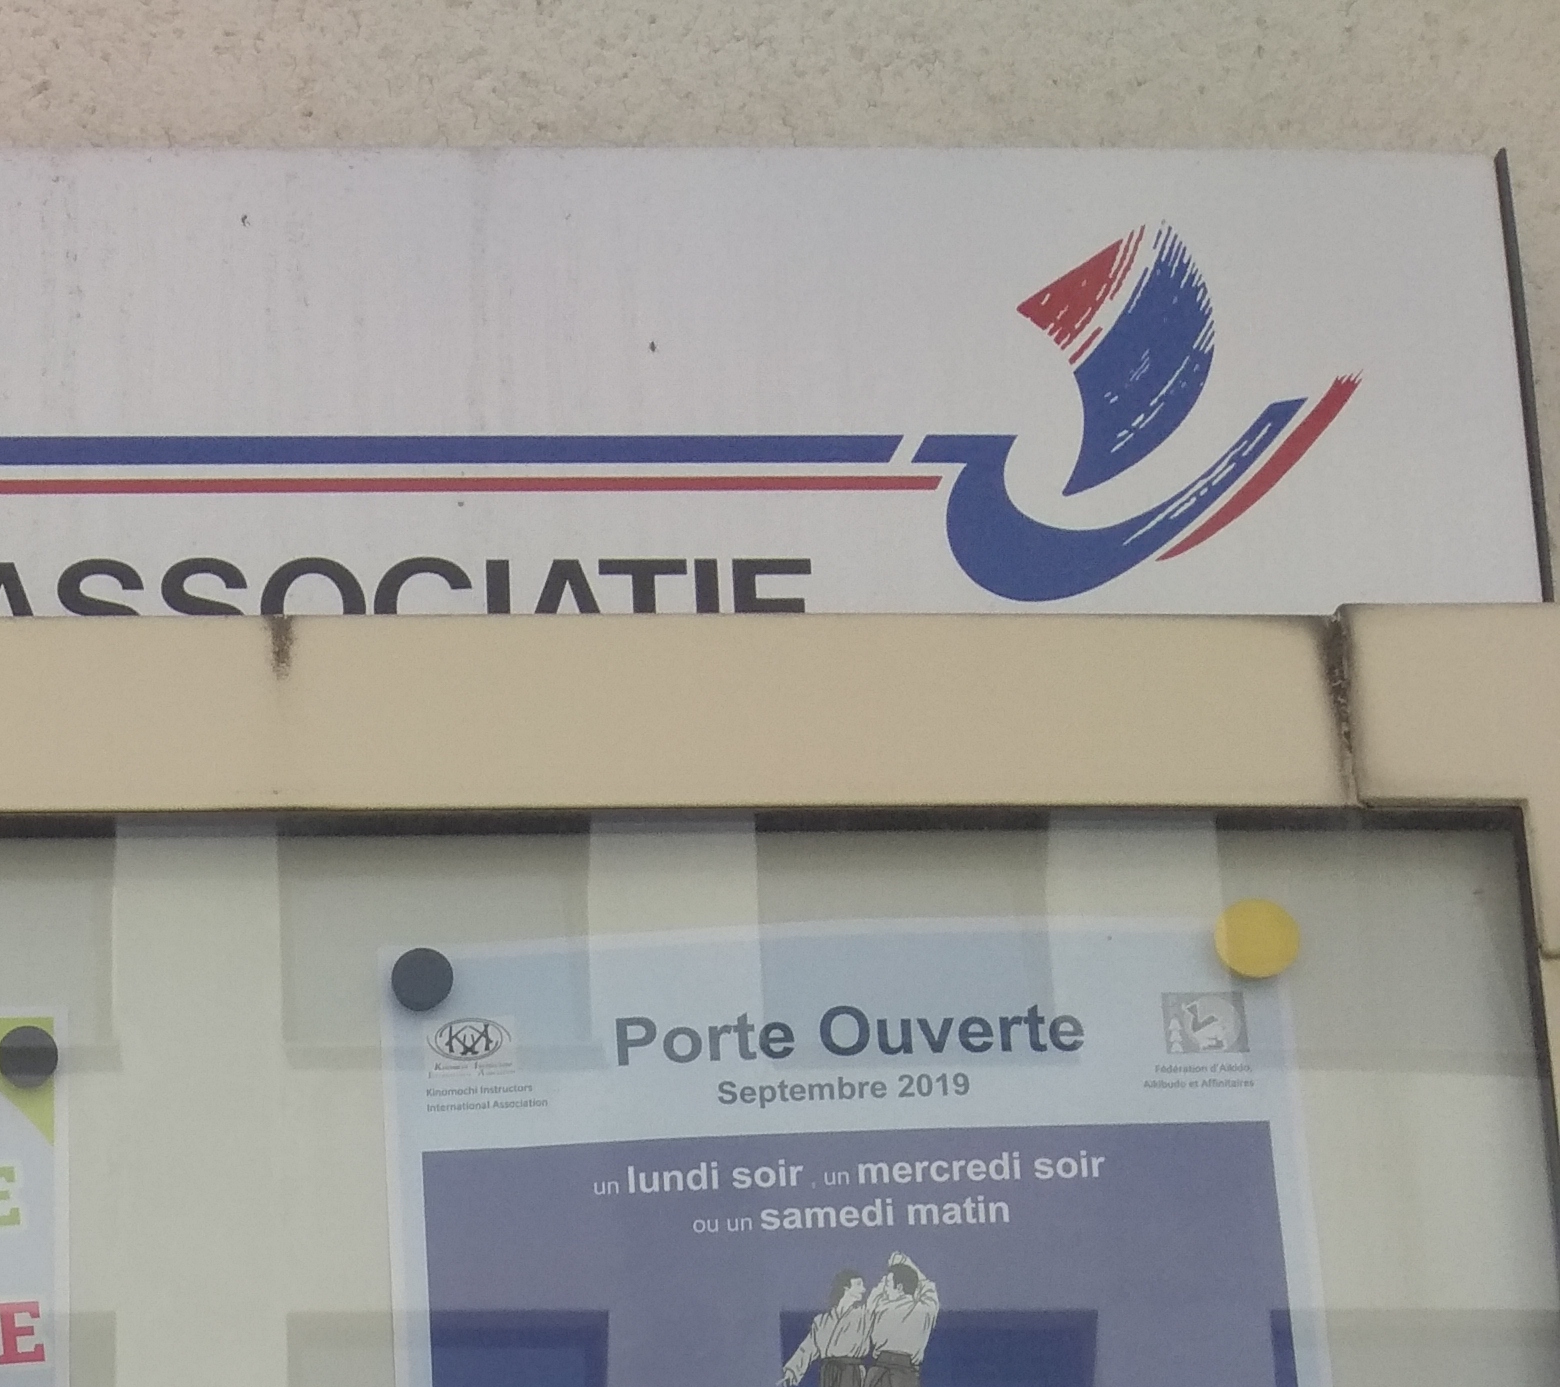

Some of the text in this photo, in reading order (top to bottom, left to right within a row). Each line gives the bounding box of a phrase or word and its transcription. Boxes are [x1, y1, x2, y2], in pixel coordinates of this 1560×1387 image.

[616, 1003, 1086, 1066] Porte Ouverte
[427, 1099, 548, 1112] International Association
[716, 1071, 971, 1110] Septembre 2019
[626, 1150, 1105, 1194] lundi soir mercredi soir
[760, 1195, 1011, 1230] samedi matin
